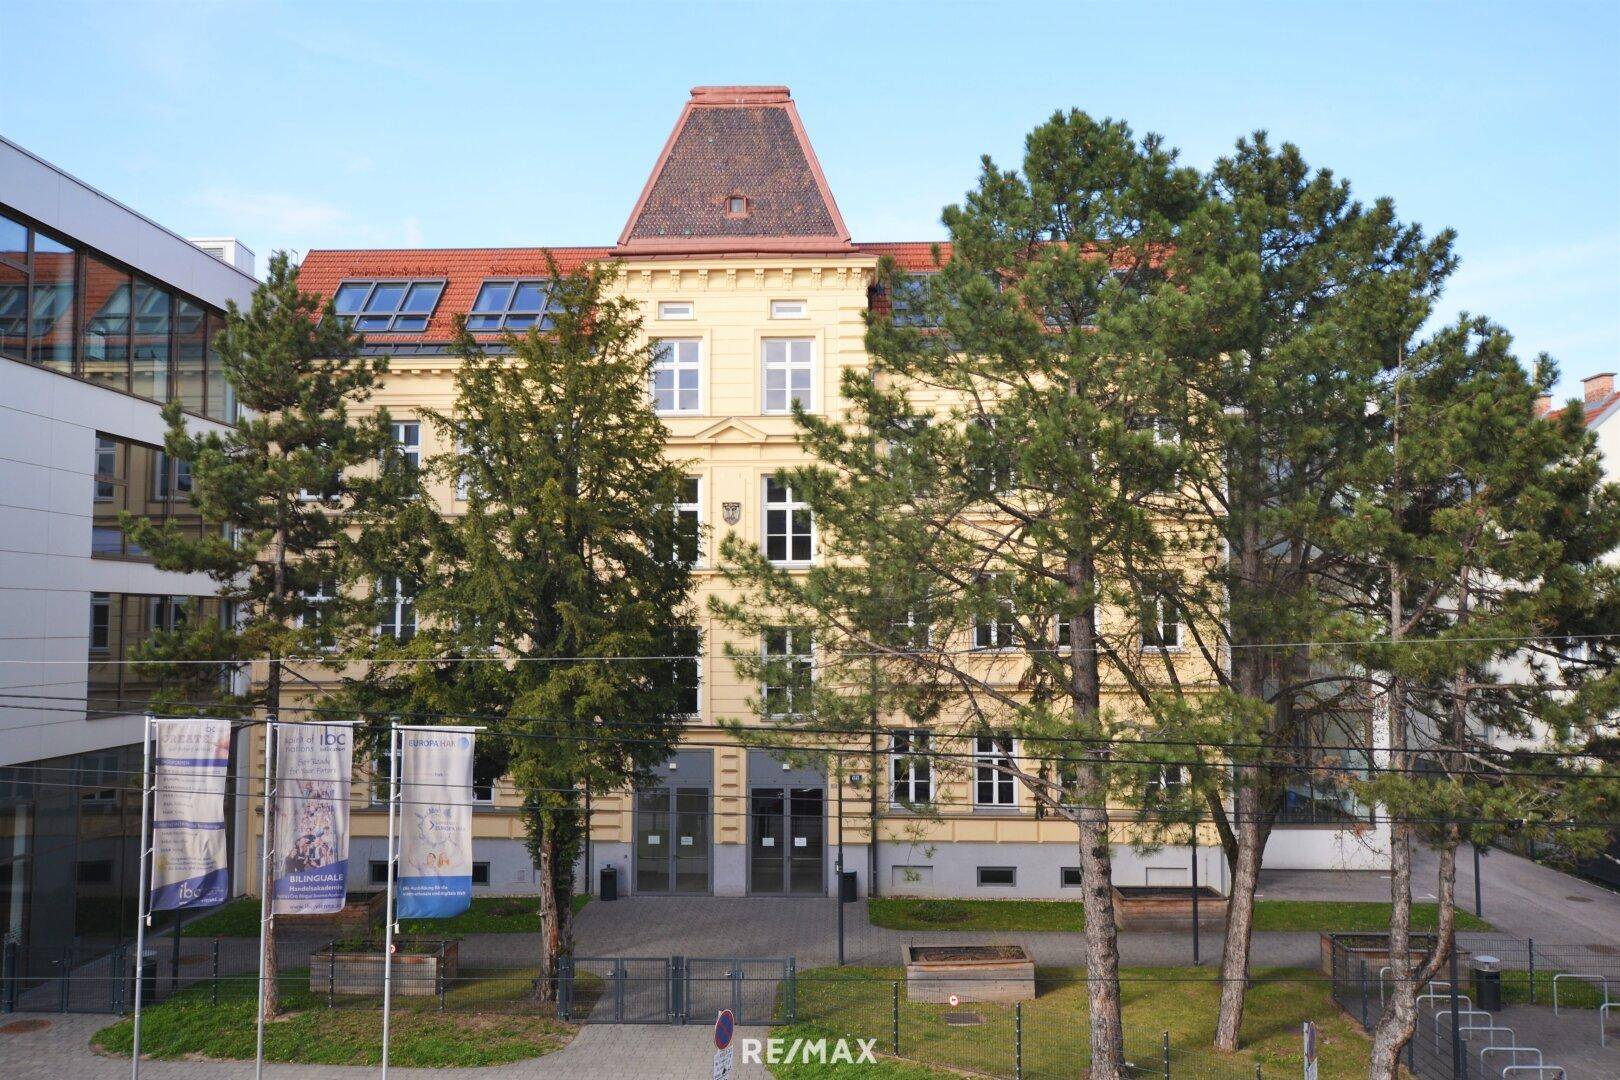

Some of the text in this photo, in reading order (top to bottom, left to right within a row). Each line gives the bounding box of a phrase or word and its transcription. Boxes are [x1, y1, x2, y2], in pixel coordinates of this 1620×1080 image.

[304, 734, 315, 744] of
[320, 725, 346, 746] ibc
[408, 739, 456, 748] EUROPA HAK
[289, 873, 344, 883] BILINGUALE
[289, 883, 343, 892] Handelsakademie
